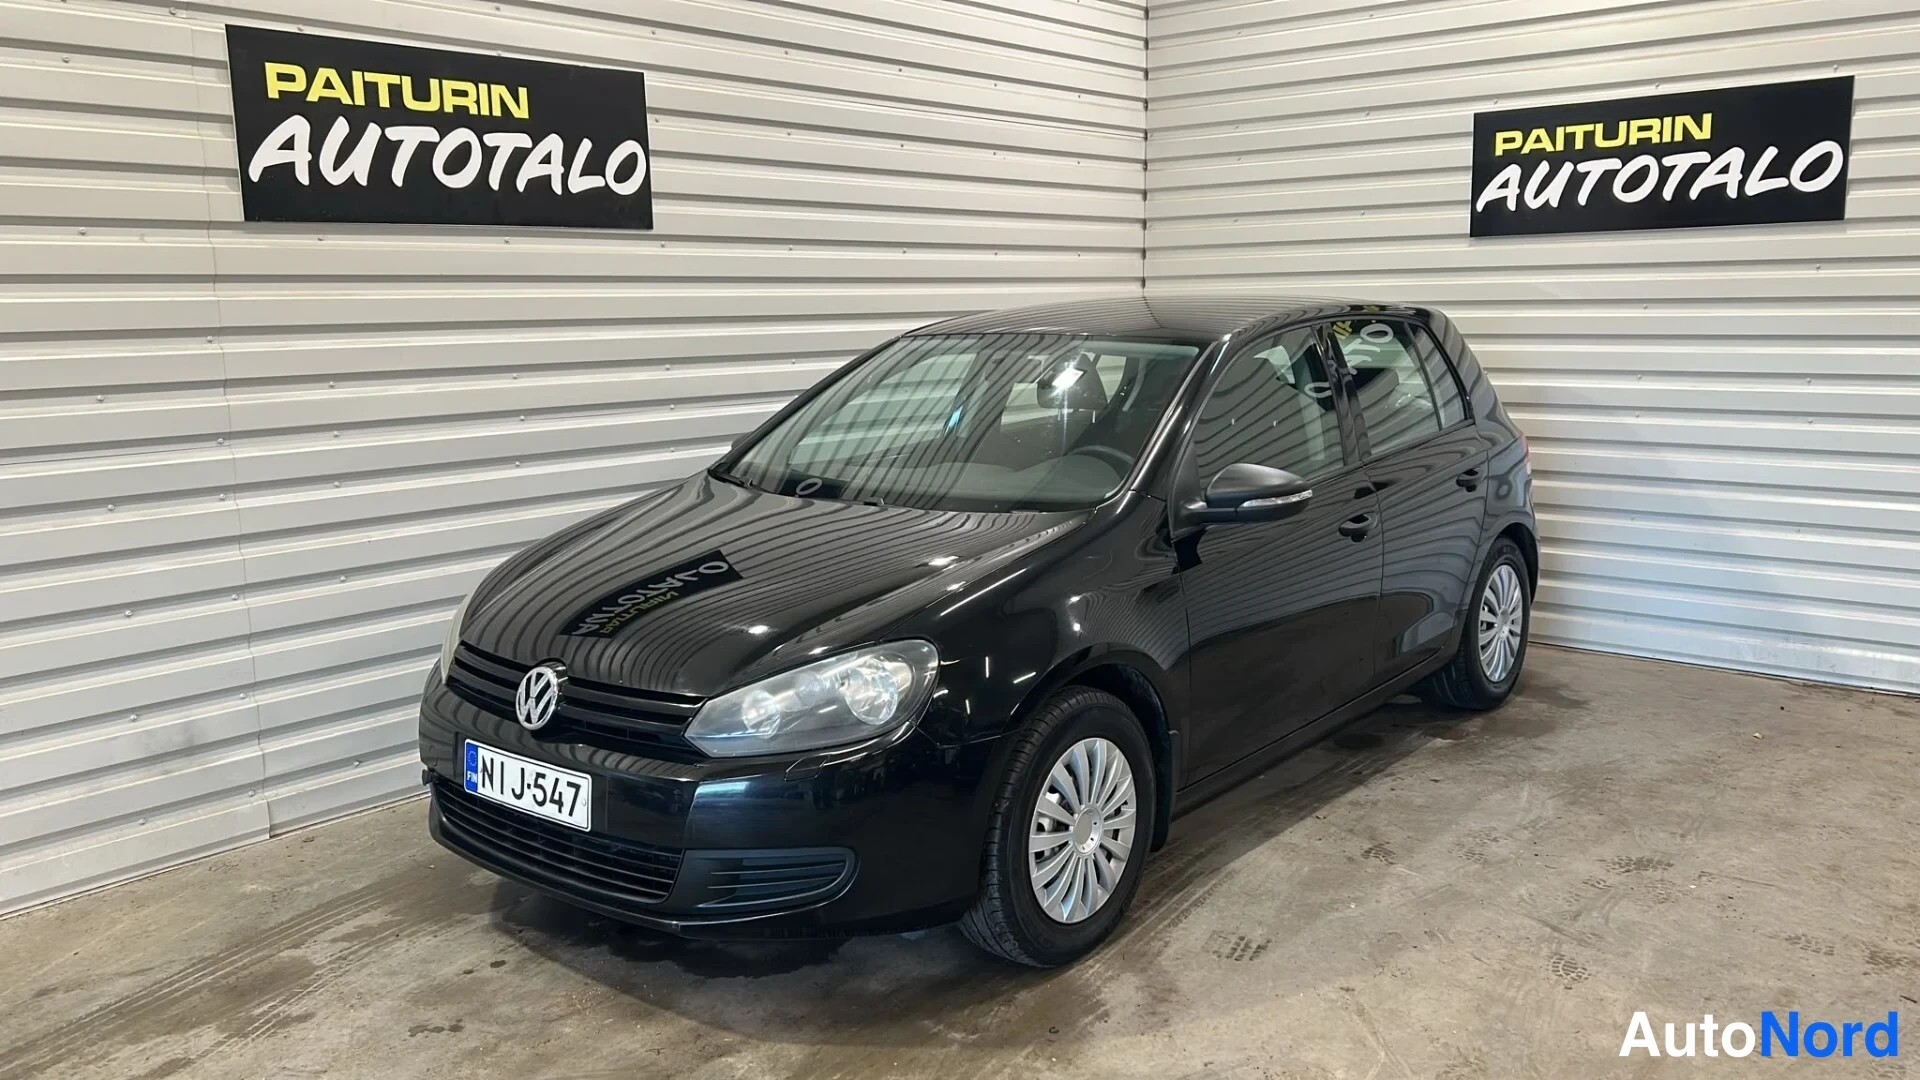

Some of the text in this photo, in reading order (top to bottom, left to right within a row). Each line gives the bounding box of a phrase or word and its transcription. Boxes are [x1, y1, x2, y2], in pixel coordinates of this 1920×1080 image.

[264, 62, 530, 119] PAITURIN
[248, 115, 647, 196] AUTOTALO
[1495, 113, 1713, 156] PAITURIN
[1476, 140, 1844, 212] AUTOTALO
[467, 771, 478, 784] FIN
[481, 755, 581, 817] NIJ-547
